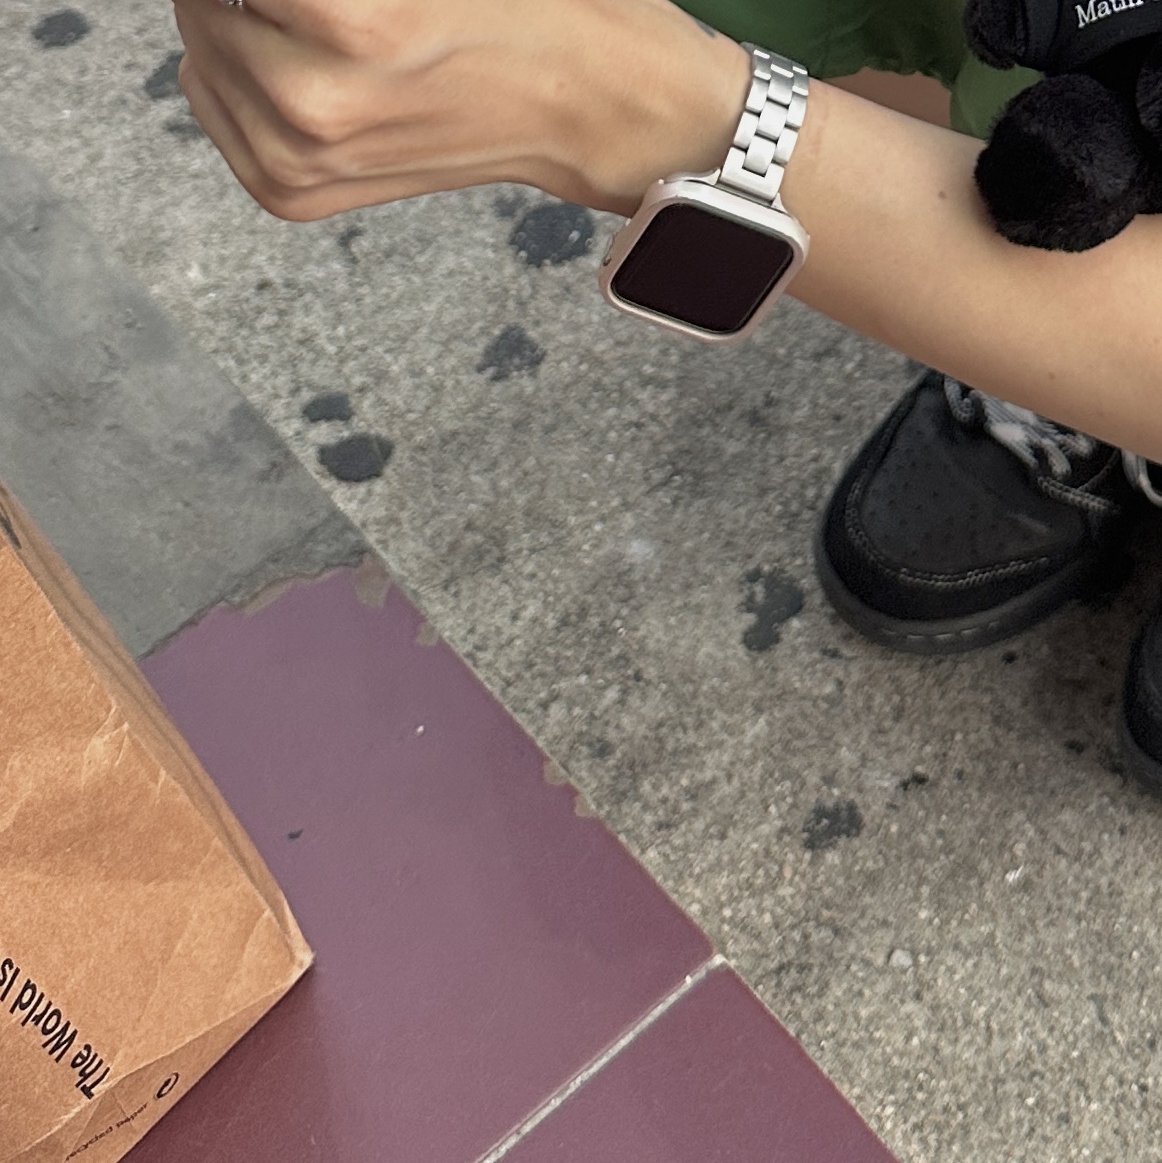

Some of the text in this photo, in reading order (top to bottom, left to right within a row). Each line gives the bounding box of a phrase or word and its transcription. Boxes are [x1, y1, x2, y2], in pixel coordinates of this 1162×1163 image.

[0, 957, 111, 1100] The World Is
[65, 1102, 149, 1161] recycled paper
